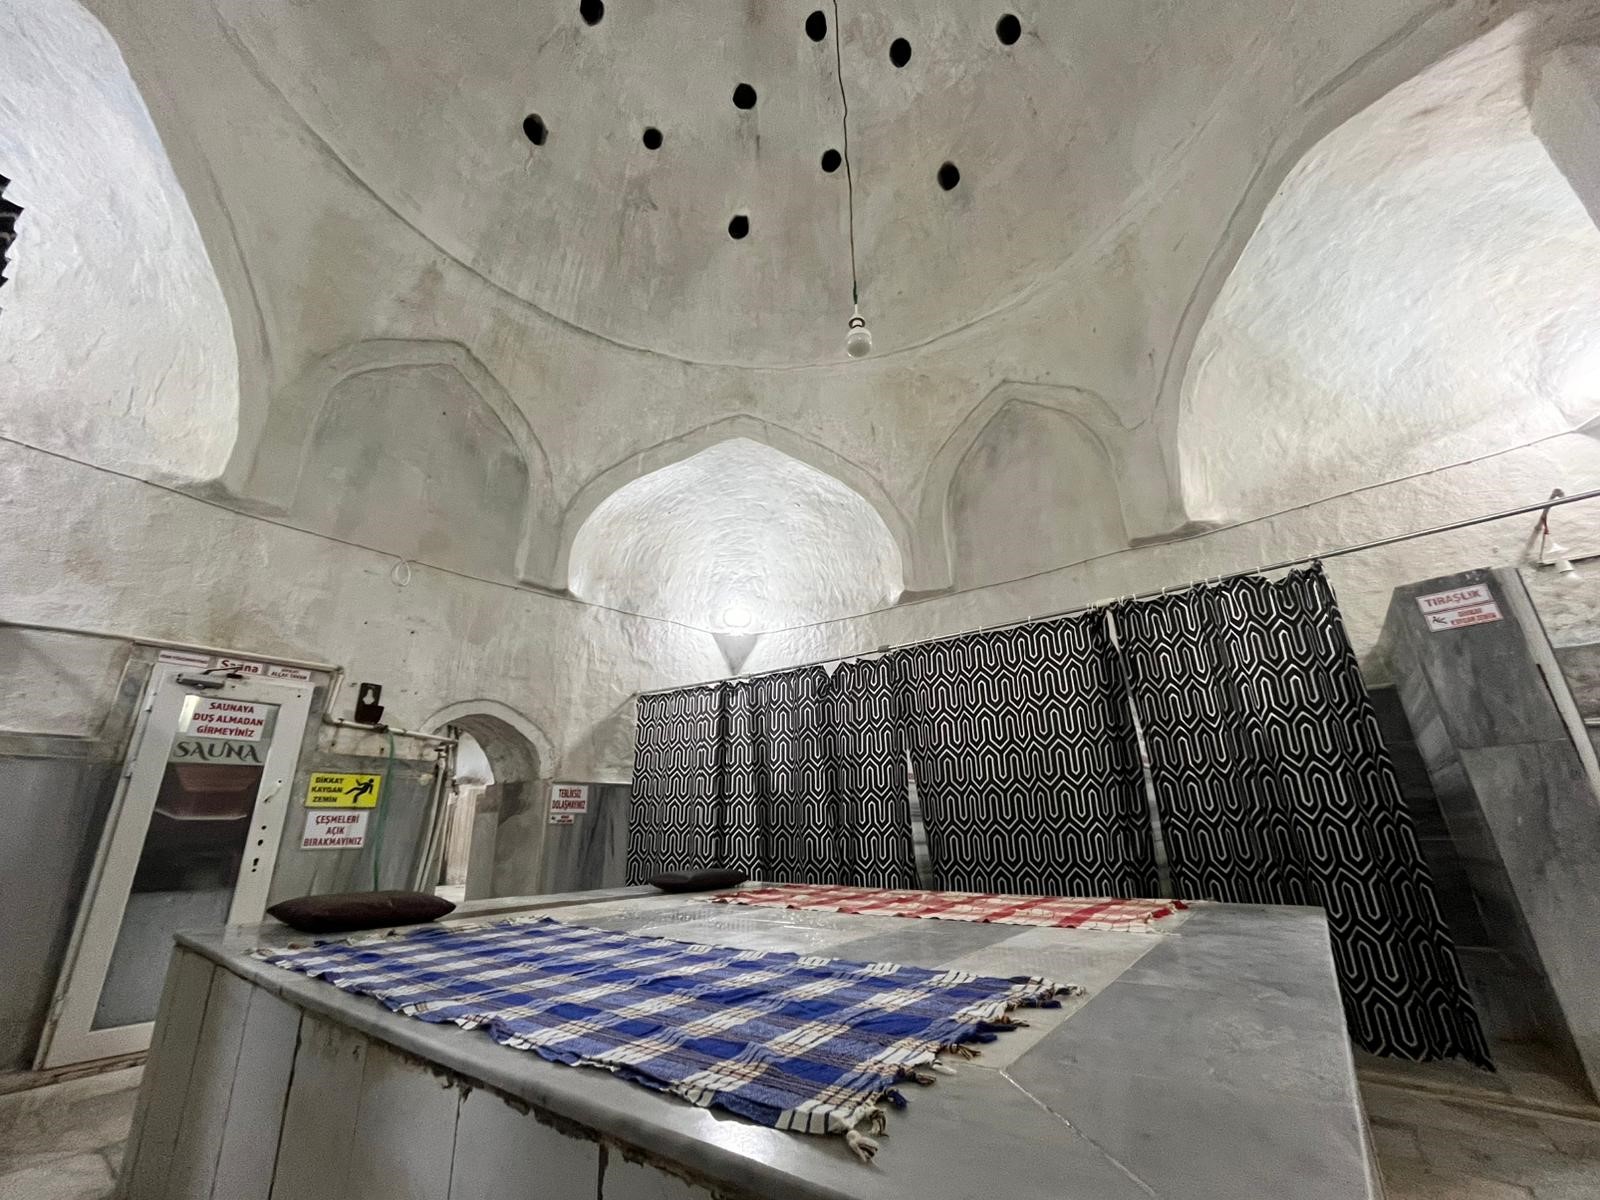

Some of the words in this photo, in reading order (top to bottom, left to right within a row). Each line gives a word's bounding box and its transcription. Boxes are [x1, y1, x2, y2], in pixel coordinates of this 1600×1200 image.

[1424, 589, 1481, 607] TIRAŞLIK
[209, 702, 254, 714] SAUNAYA
[193, 713, 215, 723] DUŞ
[216, 715, 264, 726] ALMADAN
[196, 725, 255, 737] GİRMEYİNİZ
[174, 741, 262, 763] SAUNA
[315, 814, 360, 825] ÇEŞMELERİ
[325, 826, 345, 836] AÇIK
[303, 837, 362, 847] BIRAKMAYINIZ
